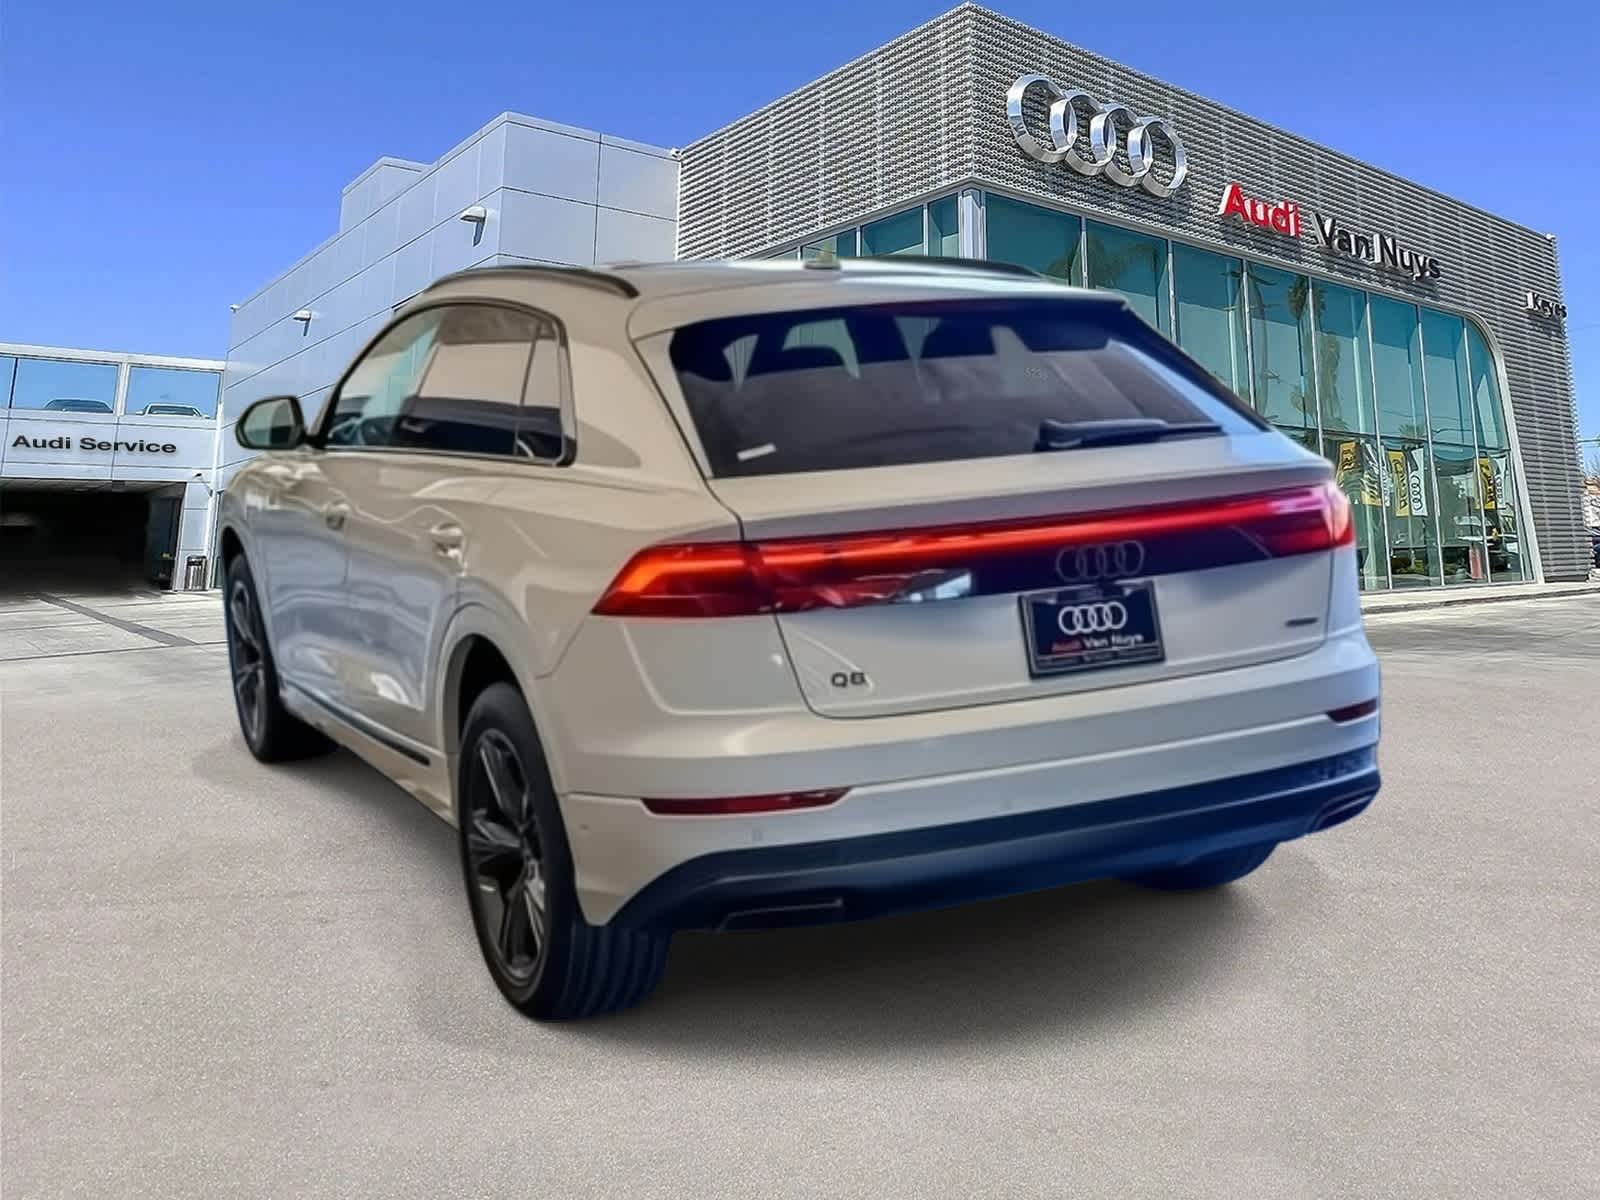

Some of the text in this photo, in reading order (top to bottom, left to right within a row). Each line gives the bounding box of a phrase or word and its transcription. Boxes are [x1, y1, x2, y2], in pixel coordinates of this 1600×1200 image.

[1217, 182, 1441, 281] Audi Van Nuys
[1526, 292, 1568, 319] Keyes
[12, 435, 177, 453] Audi Service
[1083, 635, 1109, 648] Van
